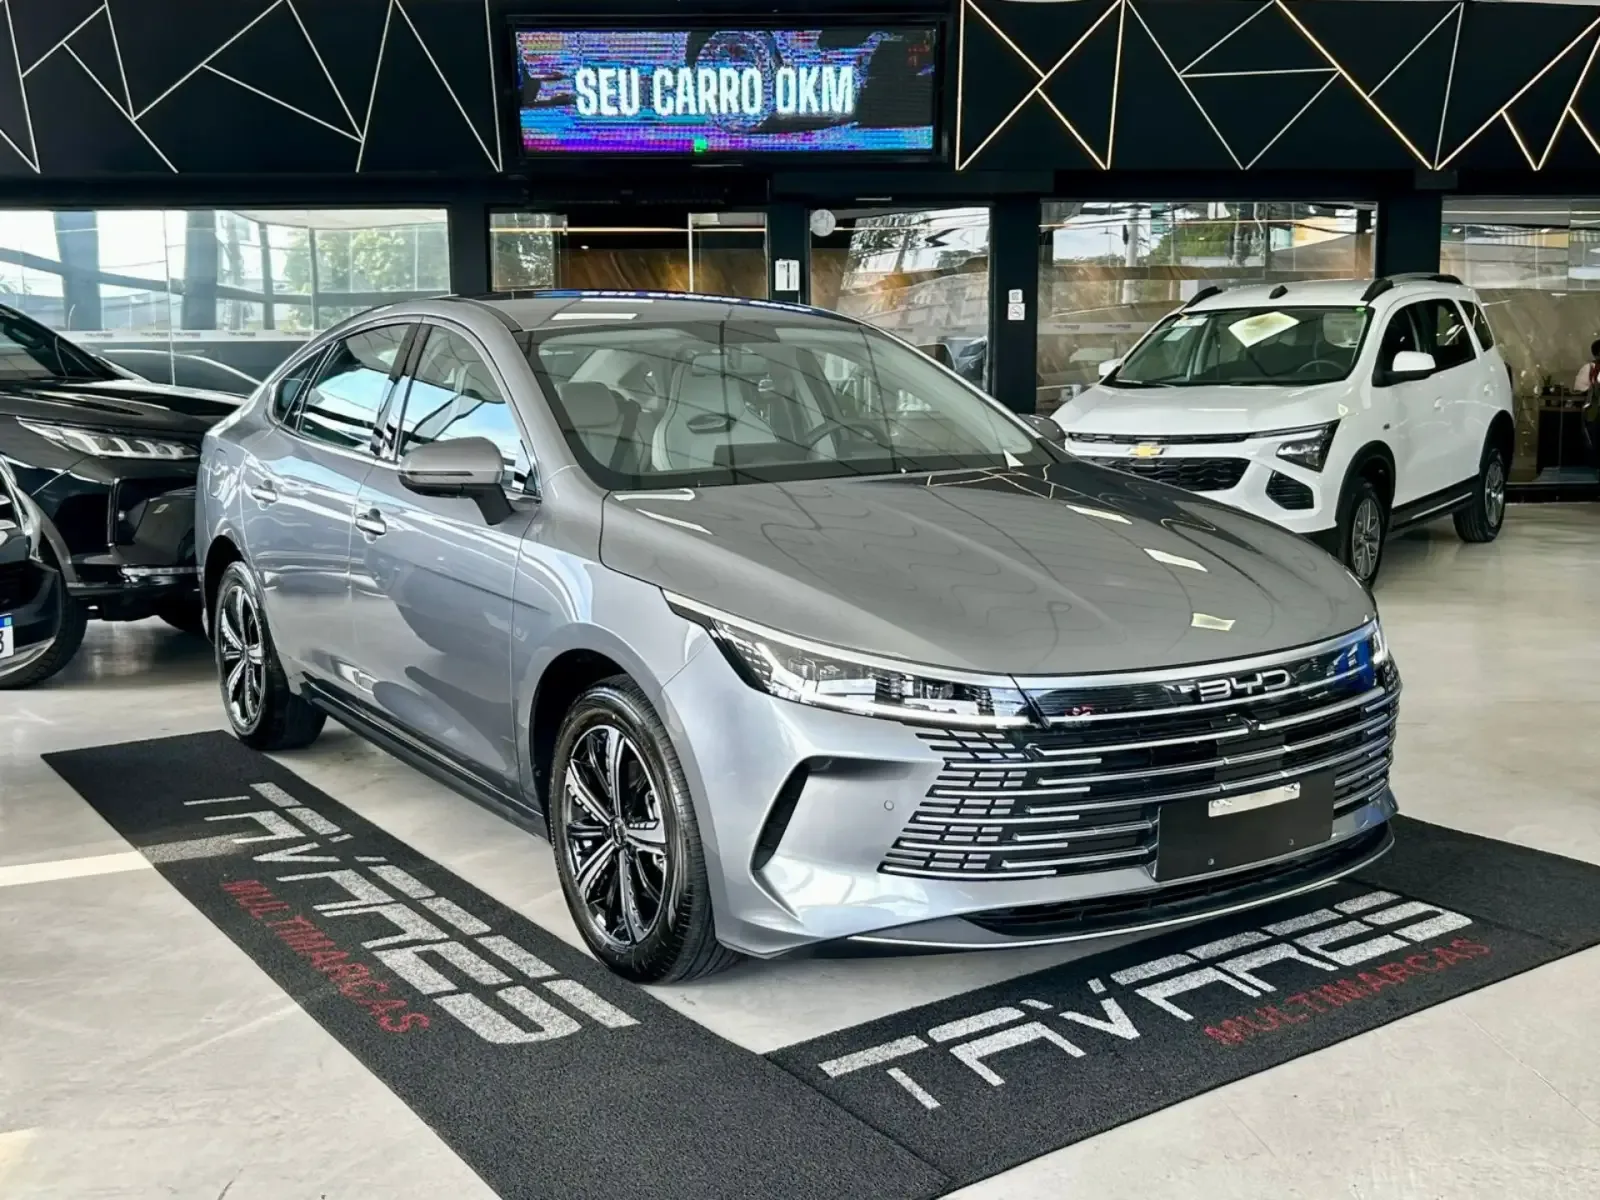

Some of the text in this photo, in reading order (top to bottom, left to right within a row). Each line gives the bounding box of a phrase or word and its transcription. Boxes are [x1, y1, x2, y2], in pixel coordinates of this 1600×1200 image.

[575, 66, 640, 116] SEU
[653, 66, 764, 116] CARRO
[1197, 669, 1291, 702] BYD
[183, 782, 641, 1044] TAVARES
[220, 879, 431, 1033] MULTIMARCAS
[817, 890, 1474, 1110] TAVARES
[1203, 937, 1492, 1045] MULTIMARCAS
